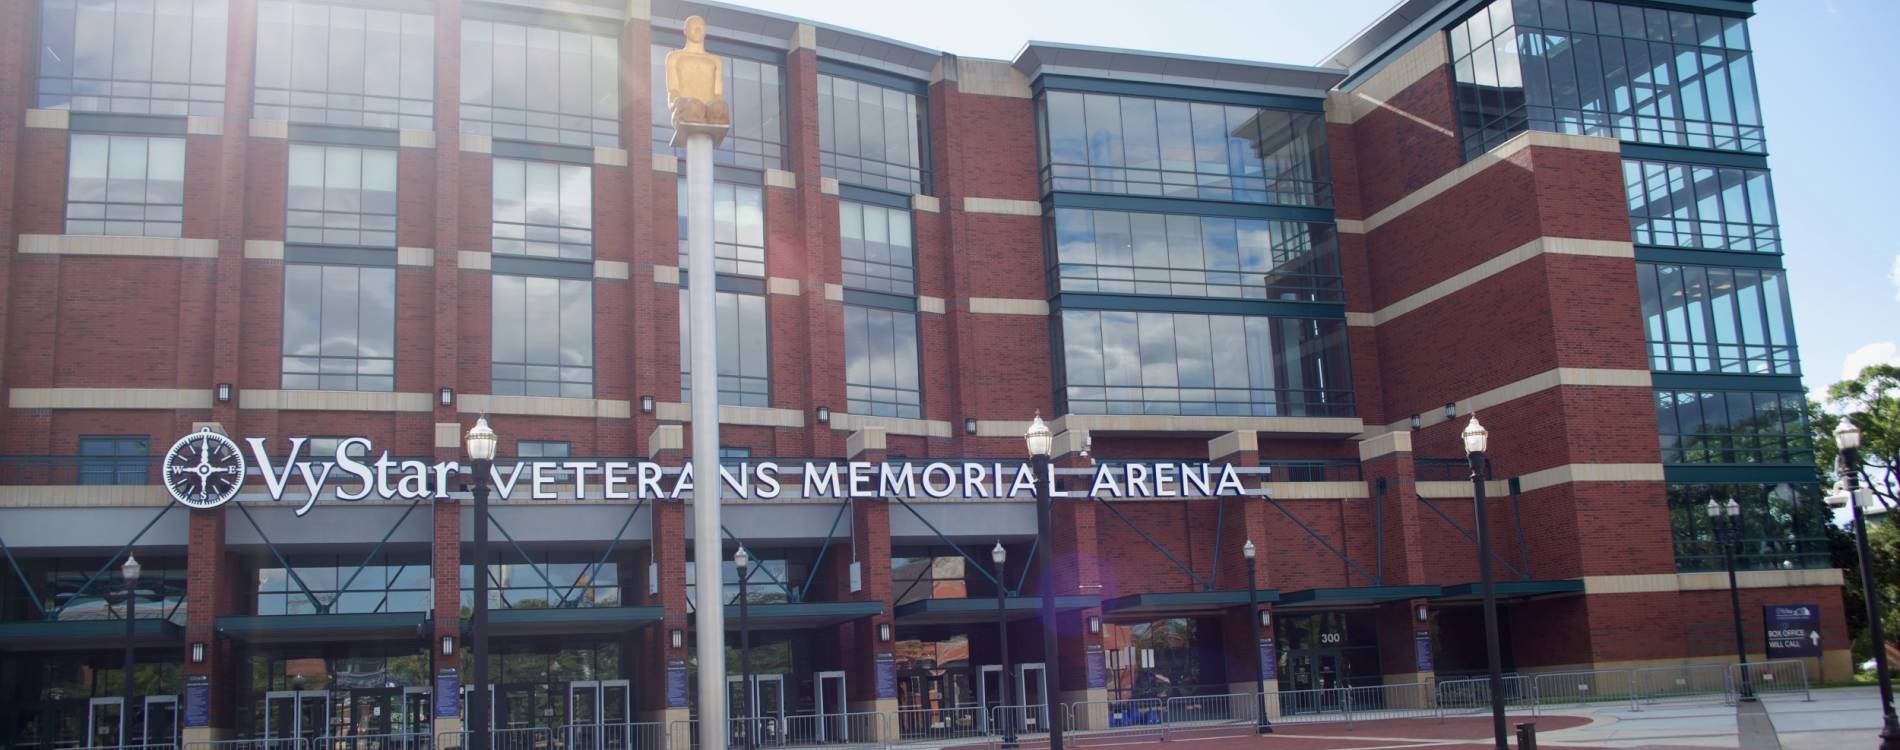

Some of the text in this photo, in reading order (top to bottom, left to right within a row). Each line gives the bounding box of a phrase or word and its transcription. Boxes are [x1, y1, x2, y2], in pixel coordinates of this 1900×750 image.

[172, 465, 183, 475] W
[228, 465, 236, 475] E
[245, 437, 1246, 517] VyStar VETERANS MEMORIAL ARENA
[1321, 633, 1340, 643] 300
[1769, 640, 1801, 648] WILL CALL
